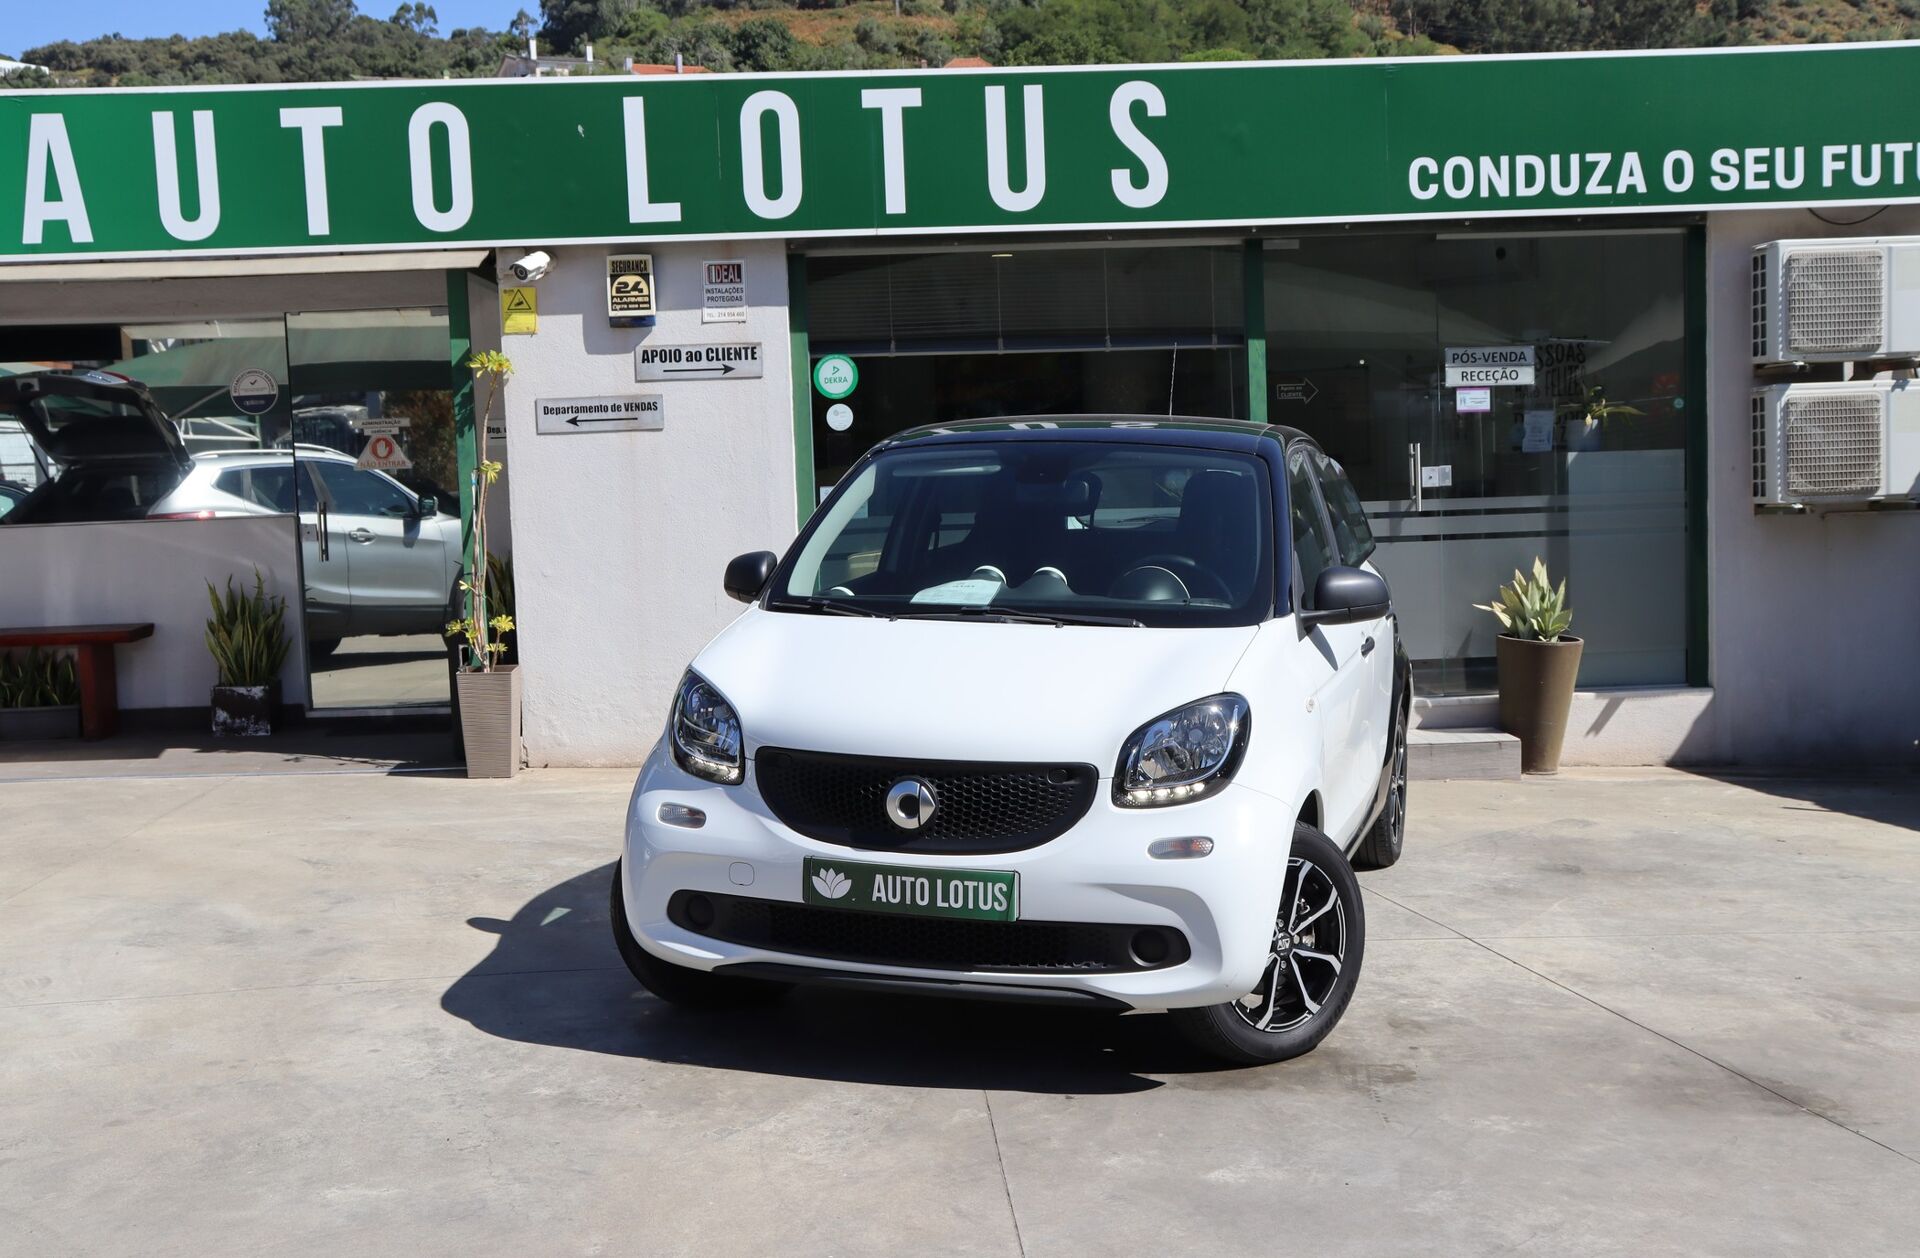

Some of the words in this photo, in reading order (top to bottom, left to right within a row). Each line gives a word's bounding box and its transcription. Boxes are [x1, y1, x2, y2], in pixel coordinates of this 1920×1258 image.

[22, 102, 473, 245] AUTO
[623, 80, 1169, 224] LOTUS
[1408, 151, 1647, 201] CONDUZA
[1662, 149, 1695, 193] O
[1710, 145, 1806, 192] SEU
[1822, 142, 1920, 188] FUT
[710, 264, 741, 284] IDEAL
[615, 281, 643, 294] 24
[705, 286, 744, 295] INSTALAÇÕES
[706, 295, 743, 303] PROTEGIDAS
[641, 349, 682, 363] APOIO
[685, 350, 702, 362] ao
[706, 347, 757, 362] CLIENTE
[1452, 349, 1527, 364] PÓS-VENDA
[824, 376, 848, 384] DEKRA
[1461, 367, 1519, 383] RECEÇÃO
[543, 404, 609, 415] Departamento
[611, 403, 622, 412] de
[624, 402, 658, 412] VENDAS
[872, 874, 930, 906] AUTO
[936, 878, 1008, 912] LOTUS
